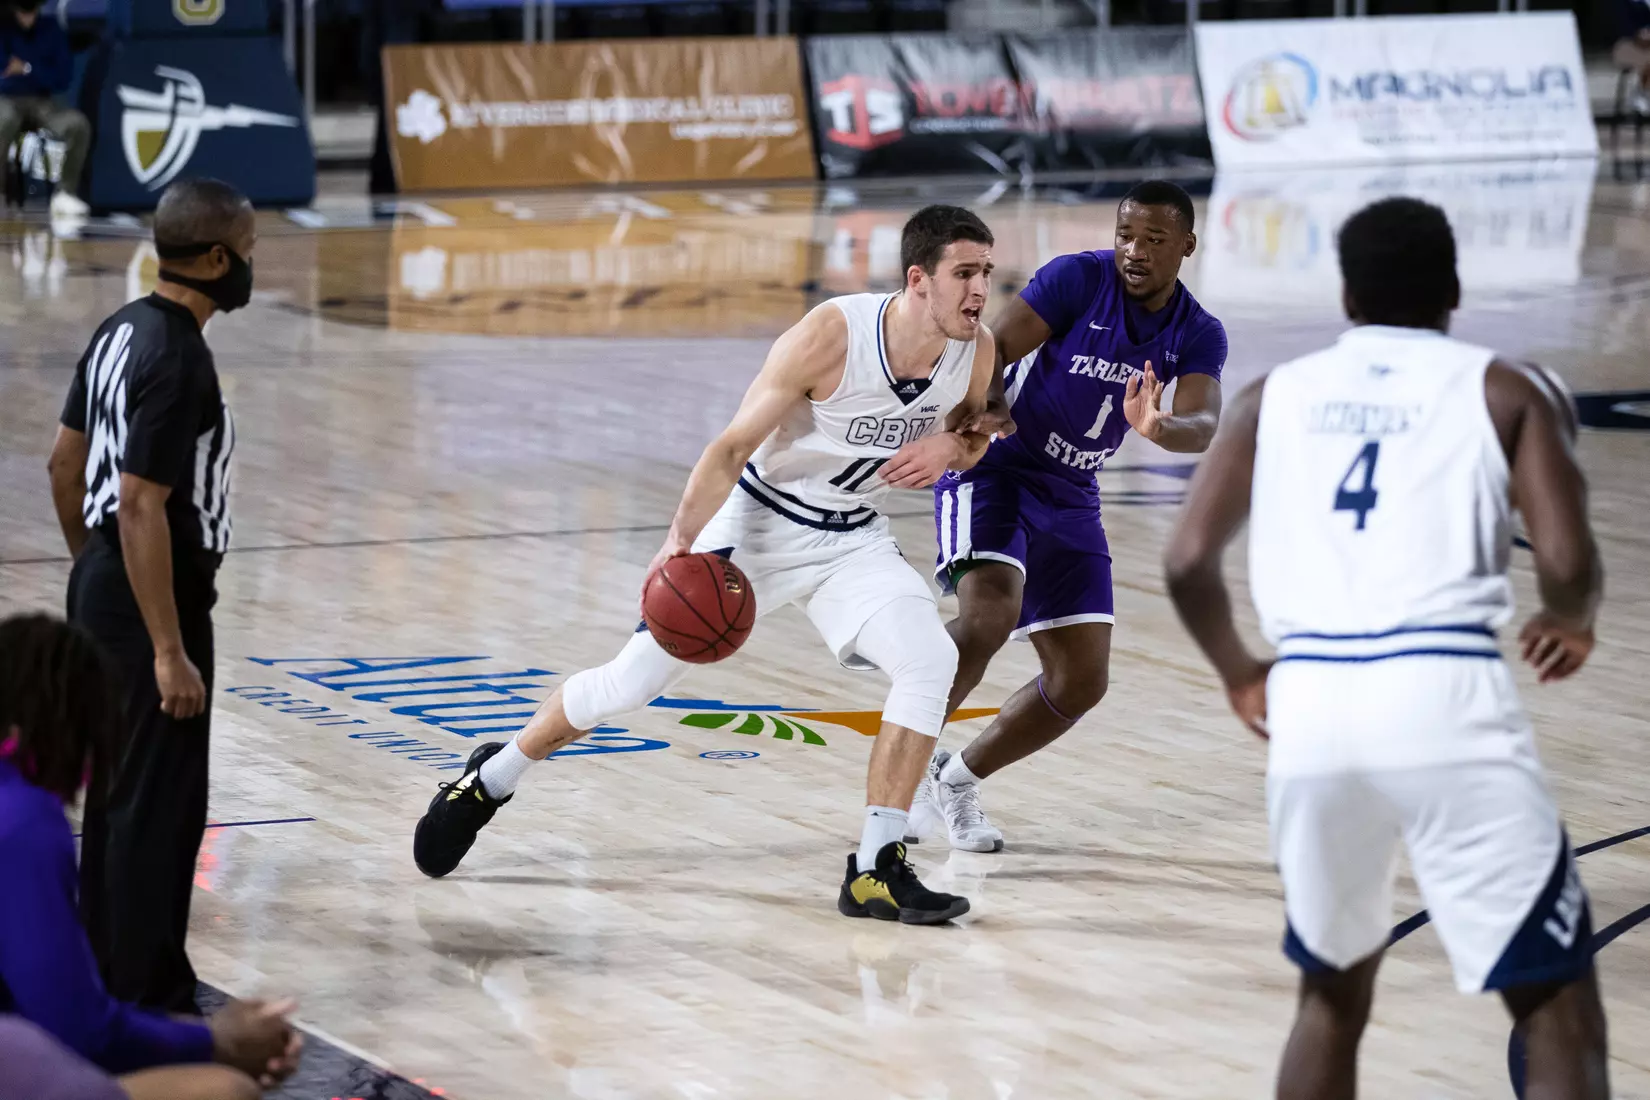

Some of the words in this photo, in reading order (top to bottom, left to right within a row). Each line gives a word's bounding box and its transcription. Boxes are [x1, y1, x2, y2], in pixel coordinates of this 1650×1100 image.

[1329, 67, 1574, 101] MAGNOLIA
[920, 404, 941, 413] WAC
[1083, 394, 1113, 440] 1
[846, 416, 936, 449] CBU
[1333, 441, 1380, 531] 4
[223, 686, 370, 726] CREDIT
